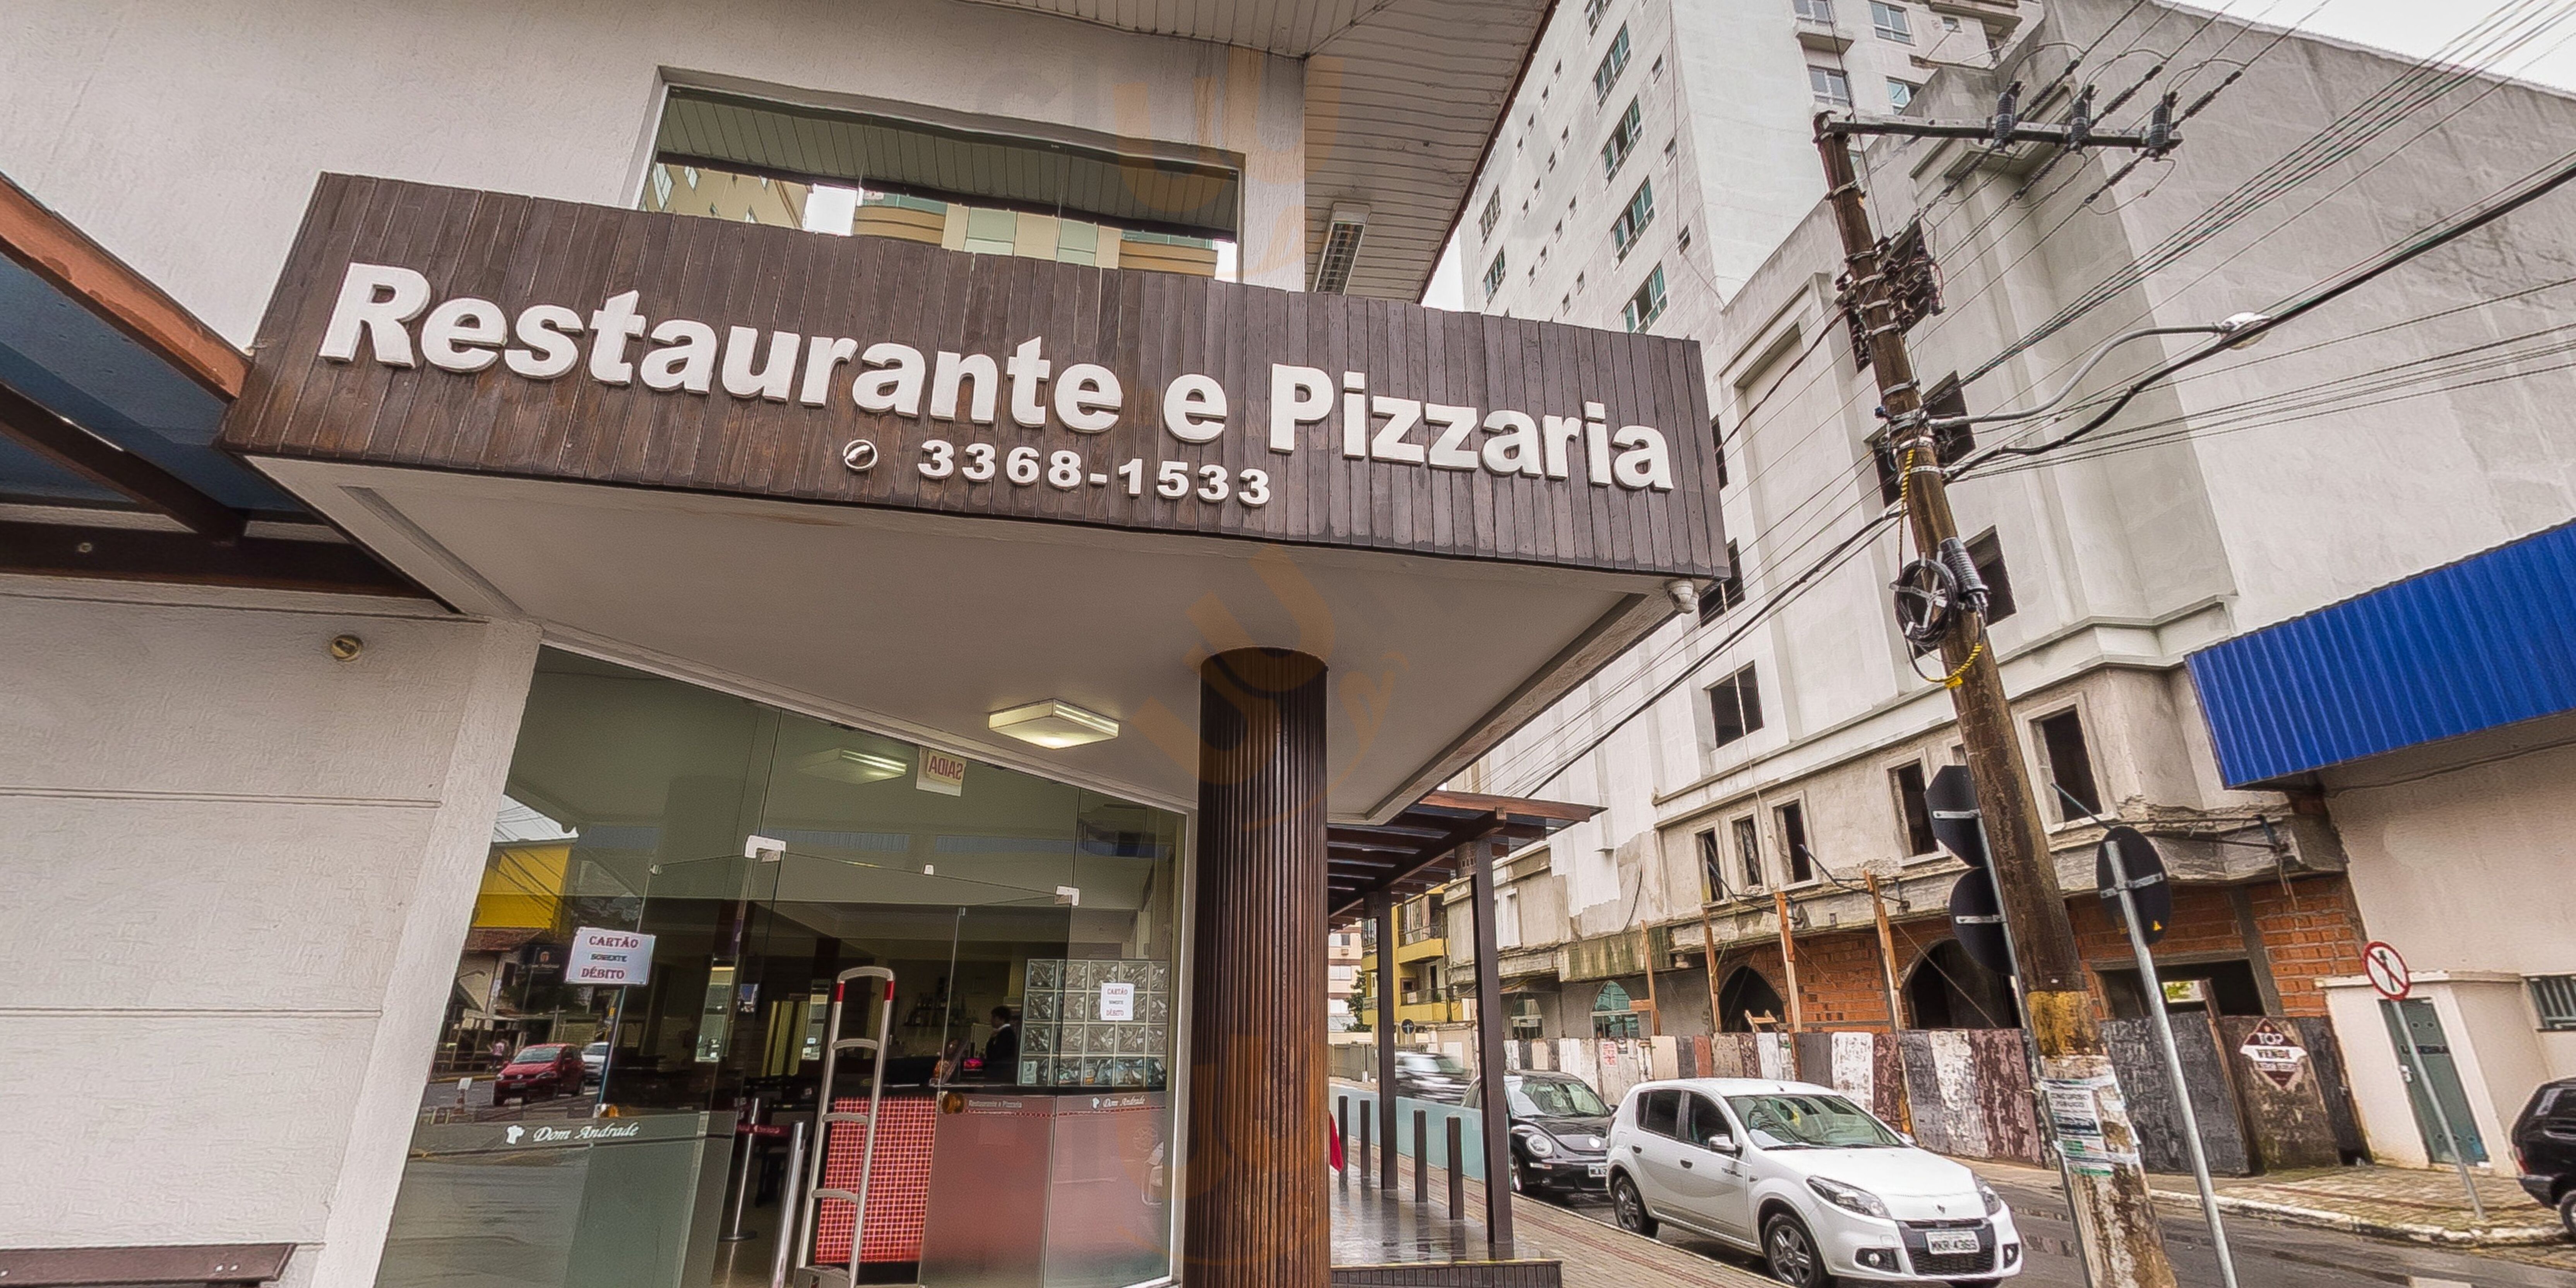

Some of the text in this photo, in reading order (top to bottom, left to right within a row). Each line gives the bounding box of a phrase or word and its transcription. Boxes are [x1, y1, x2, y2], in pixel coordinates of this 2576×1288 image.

[318, 262, 1674, 492] Restaurante e Pizzaria
[917, 439, 1271, 507] 3368-1533
[589, 936, 639, 948] CARTÃO
[581, 966, 625, 979] DÉBITO
[2256, 1032, 2284, 1045] TOP
[533, 1122, 641, 1142] Dom Andrade
